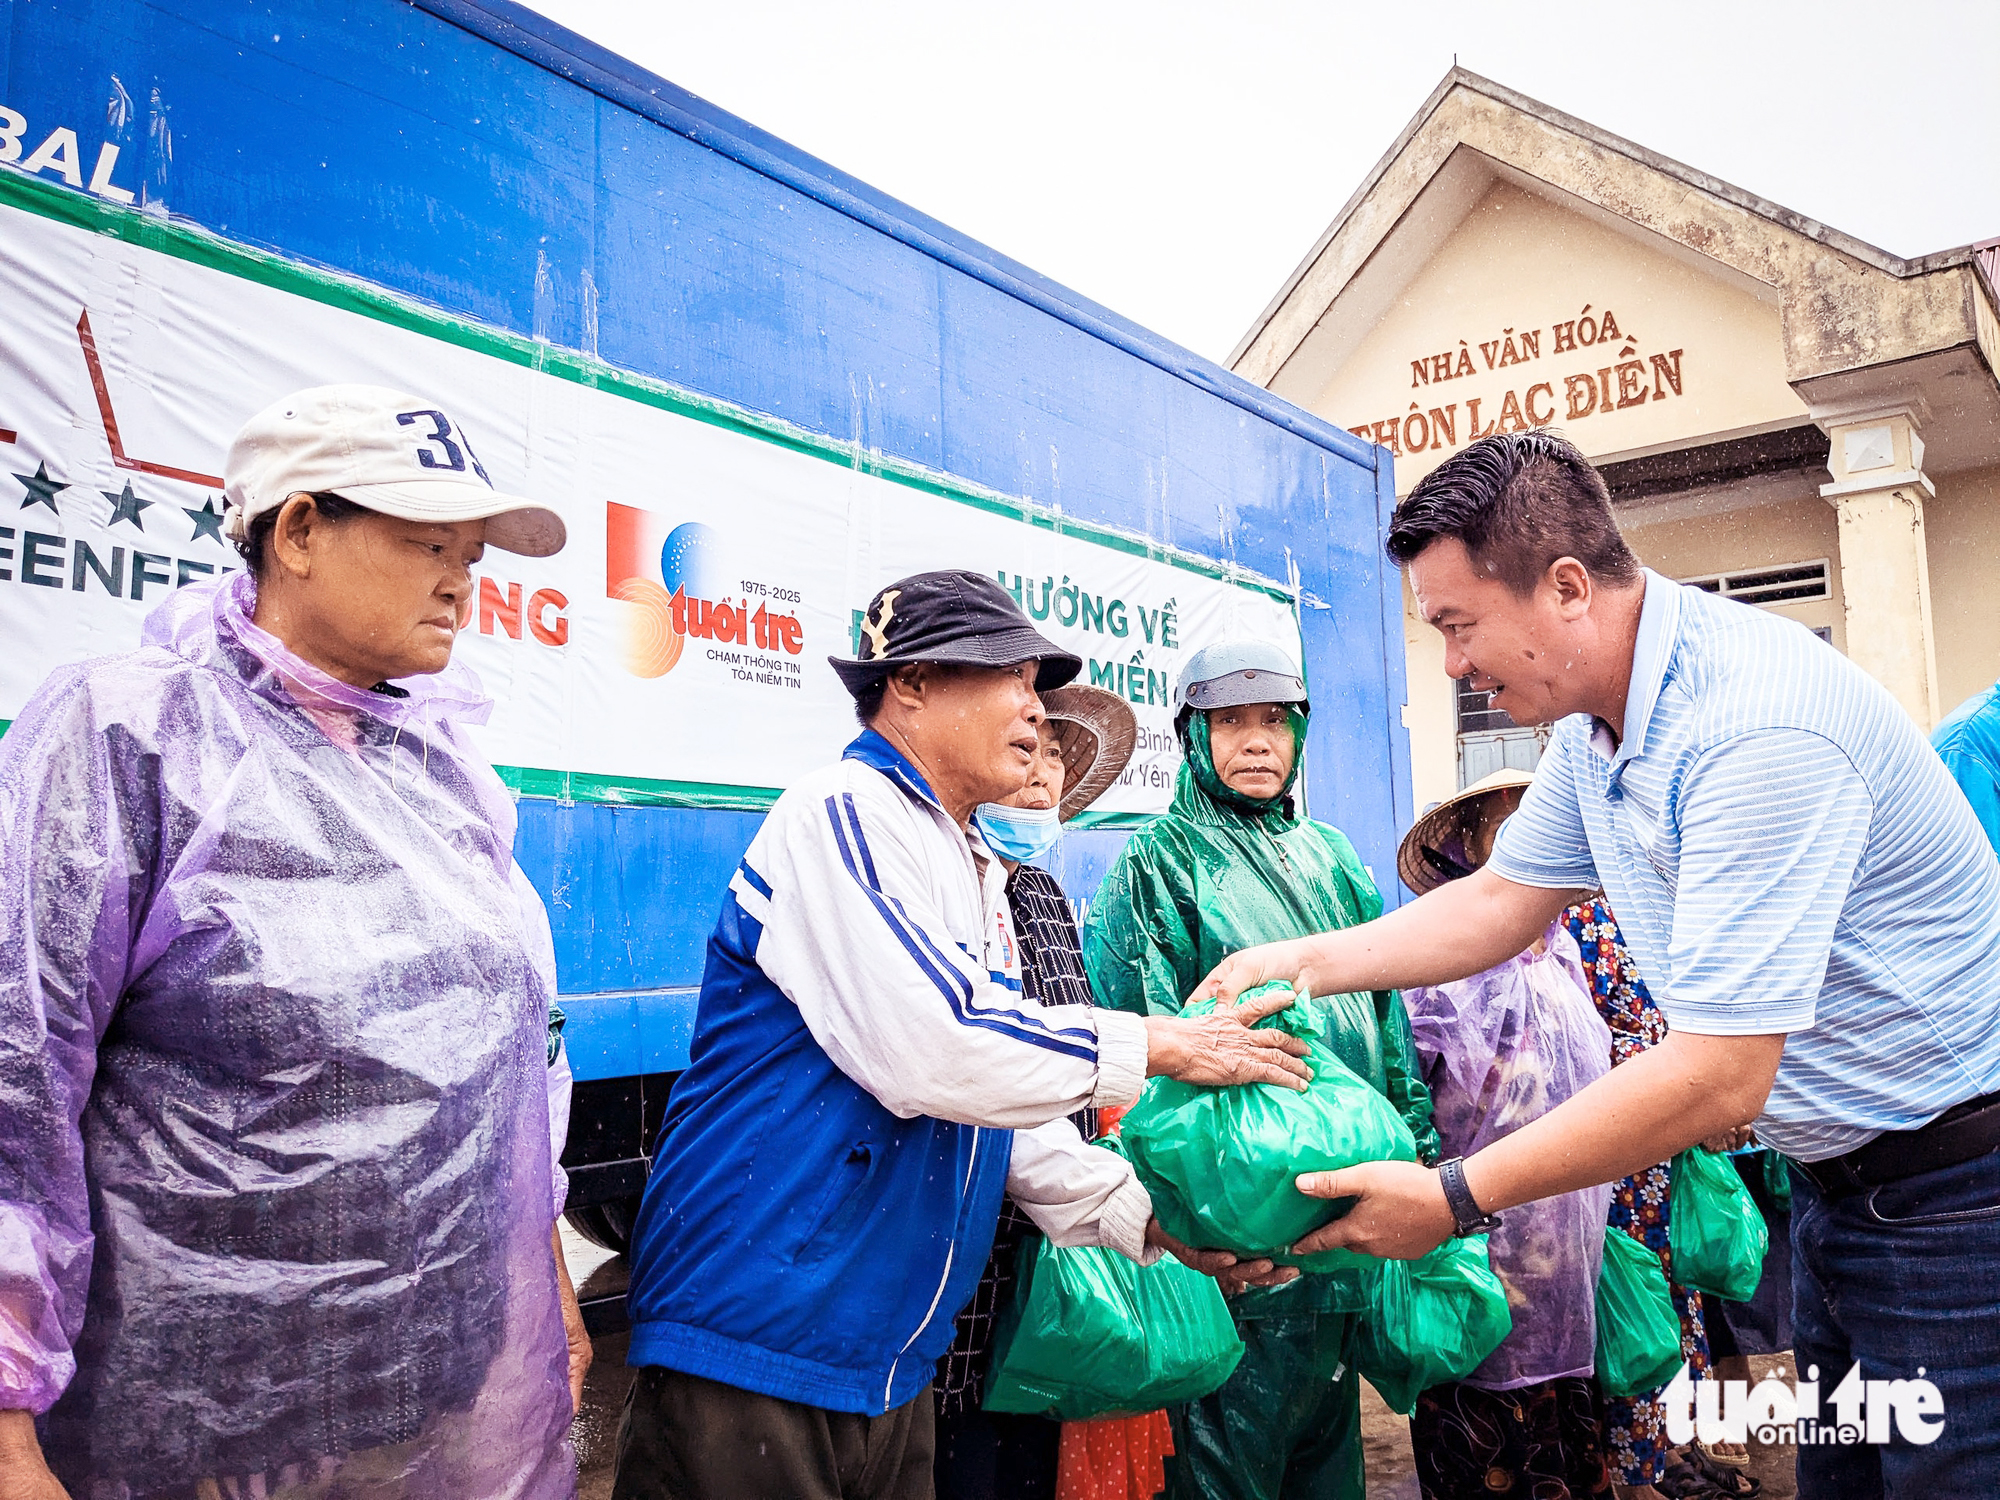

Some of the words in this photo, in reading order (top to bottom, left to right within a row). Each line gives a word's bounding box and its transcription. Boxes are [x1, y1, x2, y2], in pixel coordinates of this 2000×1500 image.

[1411, 340, 1476, 388] NHÀ
[1479, 328, 1541, 370] VĂN
[1552, 304, 1622, 354] HÓA
[1563, 334, 1683, 420] ĐIỀN
[460, 576, 569, 646] NG
[667, 582, 748, 646] tuổi
[750, 600, 804, 655] trẻ
[740, 580, 801, 603] 1975-2025
[998, 570, 1129, 638] HƯỚNG
[1137, 597, 1179, 650] VỀ
[706, 649, 741, 665] CHẠM
[743, 654, 782, 671] THÔNG
[784, 661, 801, 674] TIN
[731, 665, 754, 682] TÒA
[784, 676, 801, 689] TIN
[1089, 649, 1168, 708] MIỀN
[1136, 726, 1172, 752] Bình
[1139, 763, 1170, 789] Yên
